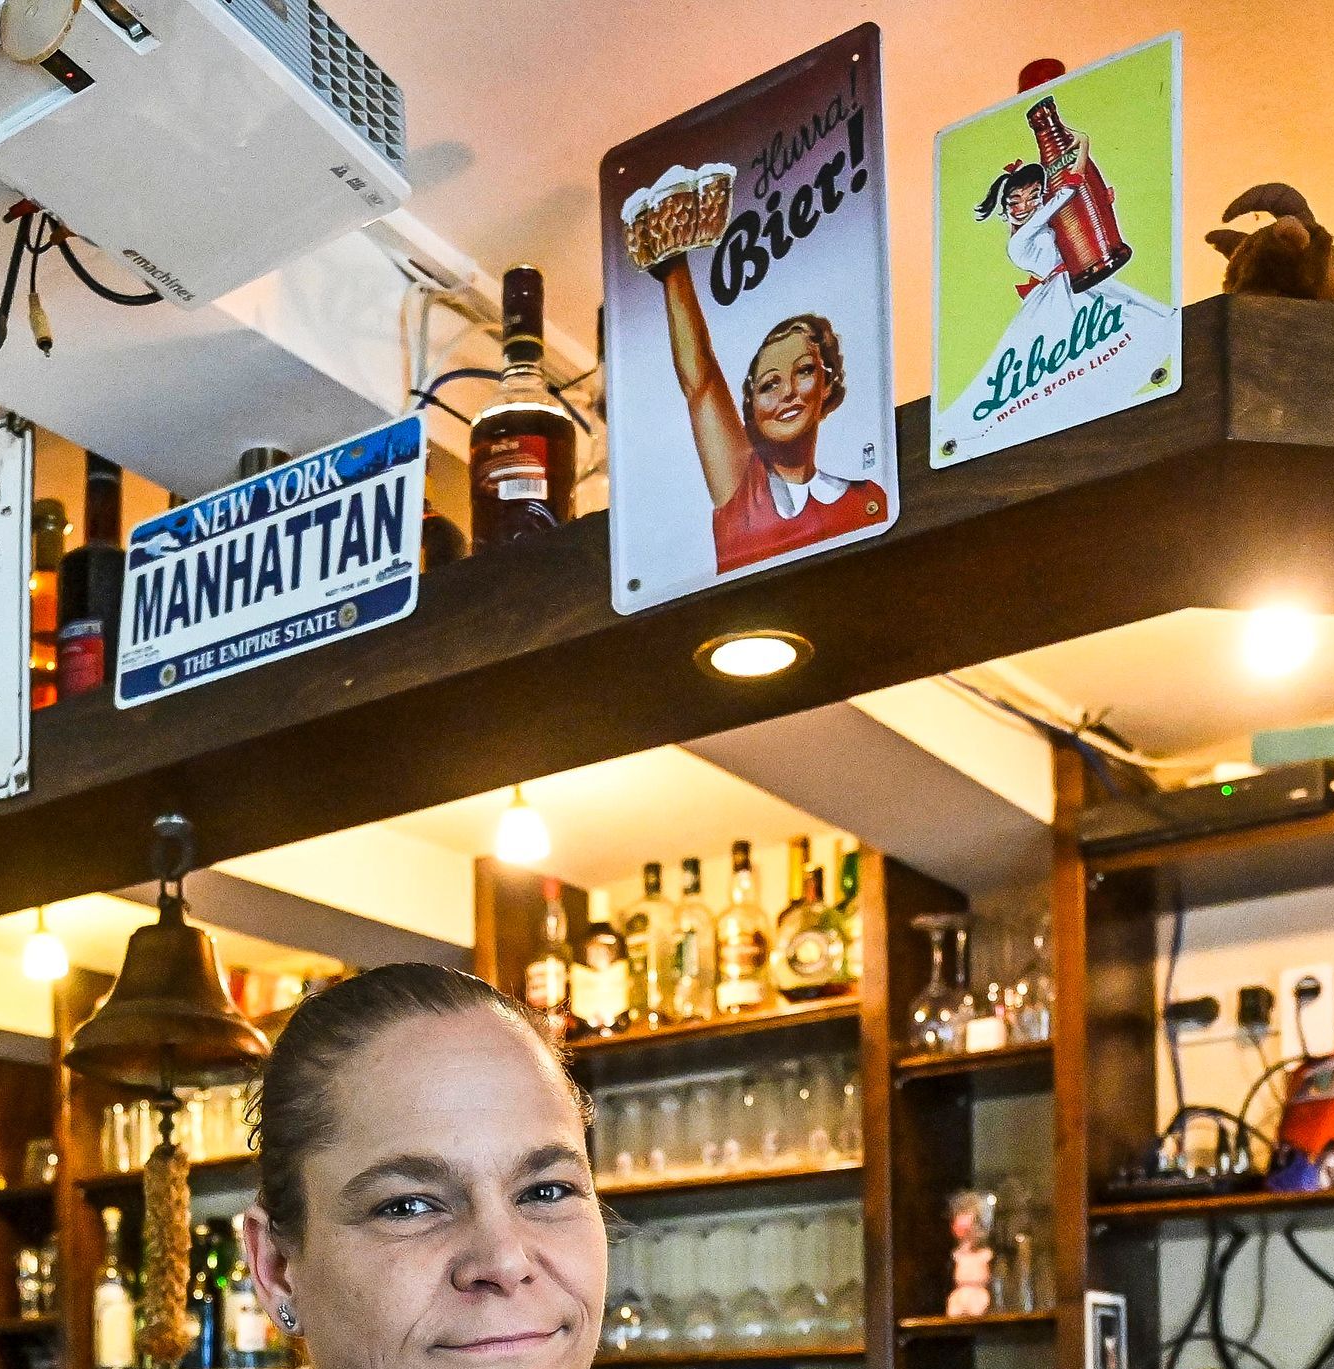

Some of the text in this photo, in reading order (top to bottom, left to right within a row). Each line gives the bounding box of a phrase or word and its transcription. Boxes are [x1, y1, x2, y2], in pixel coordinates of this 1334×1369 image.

[710, 107, 867, 306] Bier!
[972, 294, 1124, 421] Libella
[1043, 366, 1085, 397] große
[1089, 332, 1132, 370] Liebe!
[190, 450, 345, 543] NEW YORK
[132, 476, 405, 646] MANHATTAN
[182, 650, 215, 676] THE
[218, 631, 280, 664] EMPIRE
[284, 610, 337, 642] STATE
